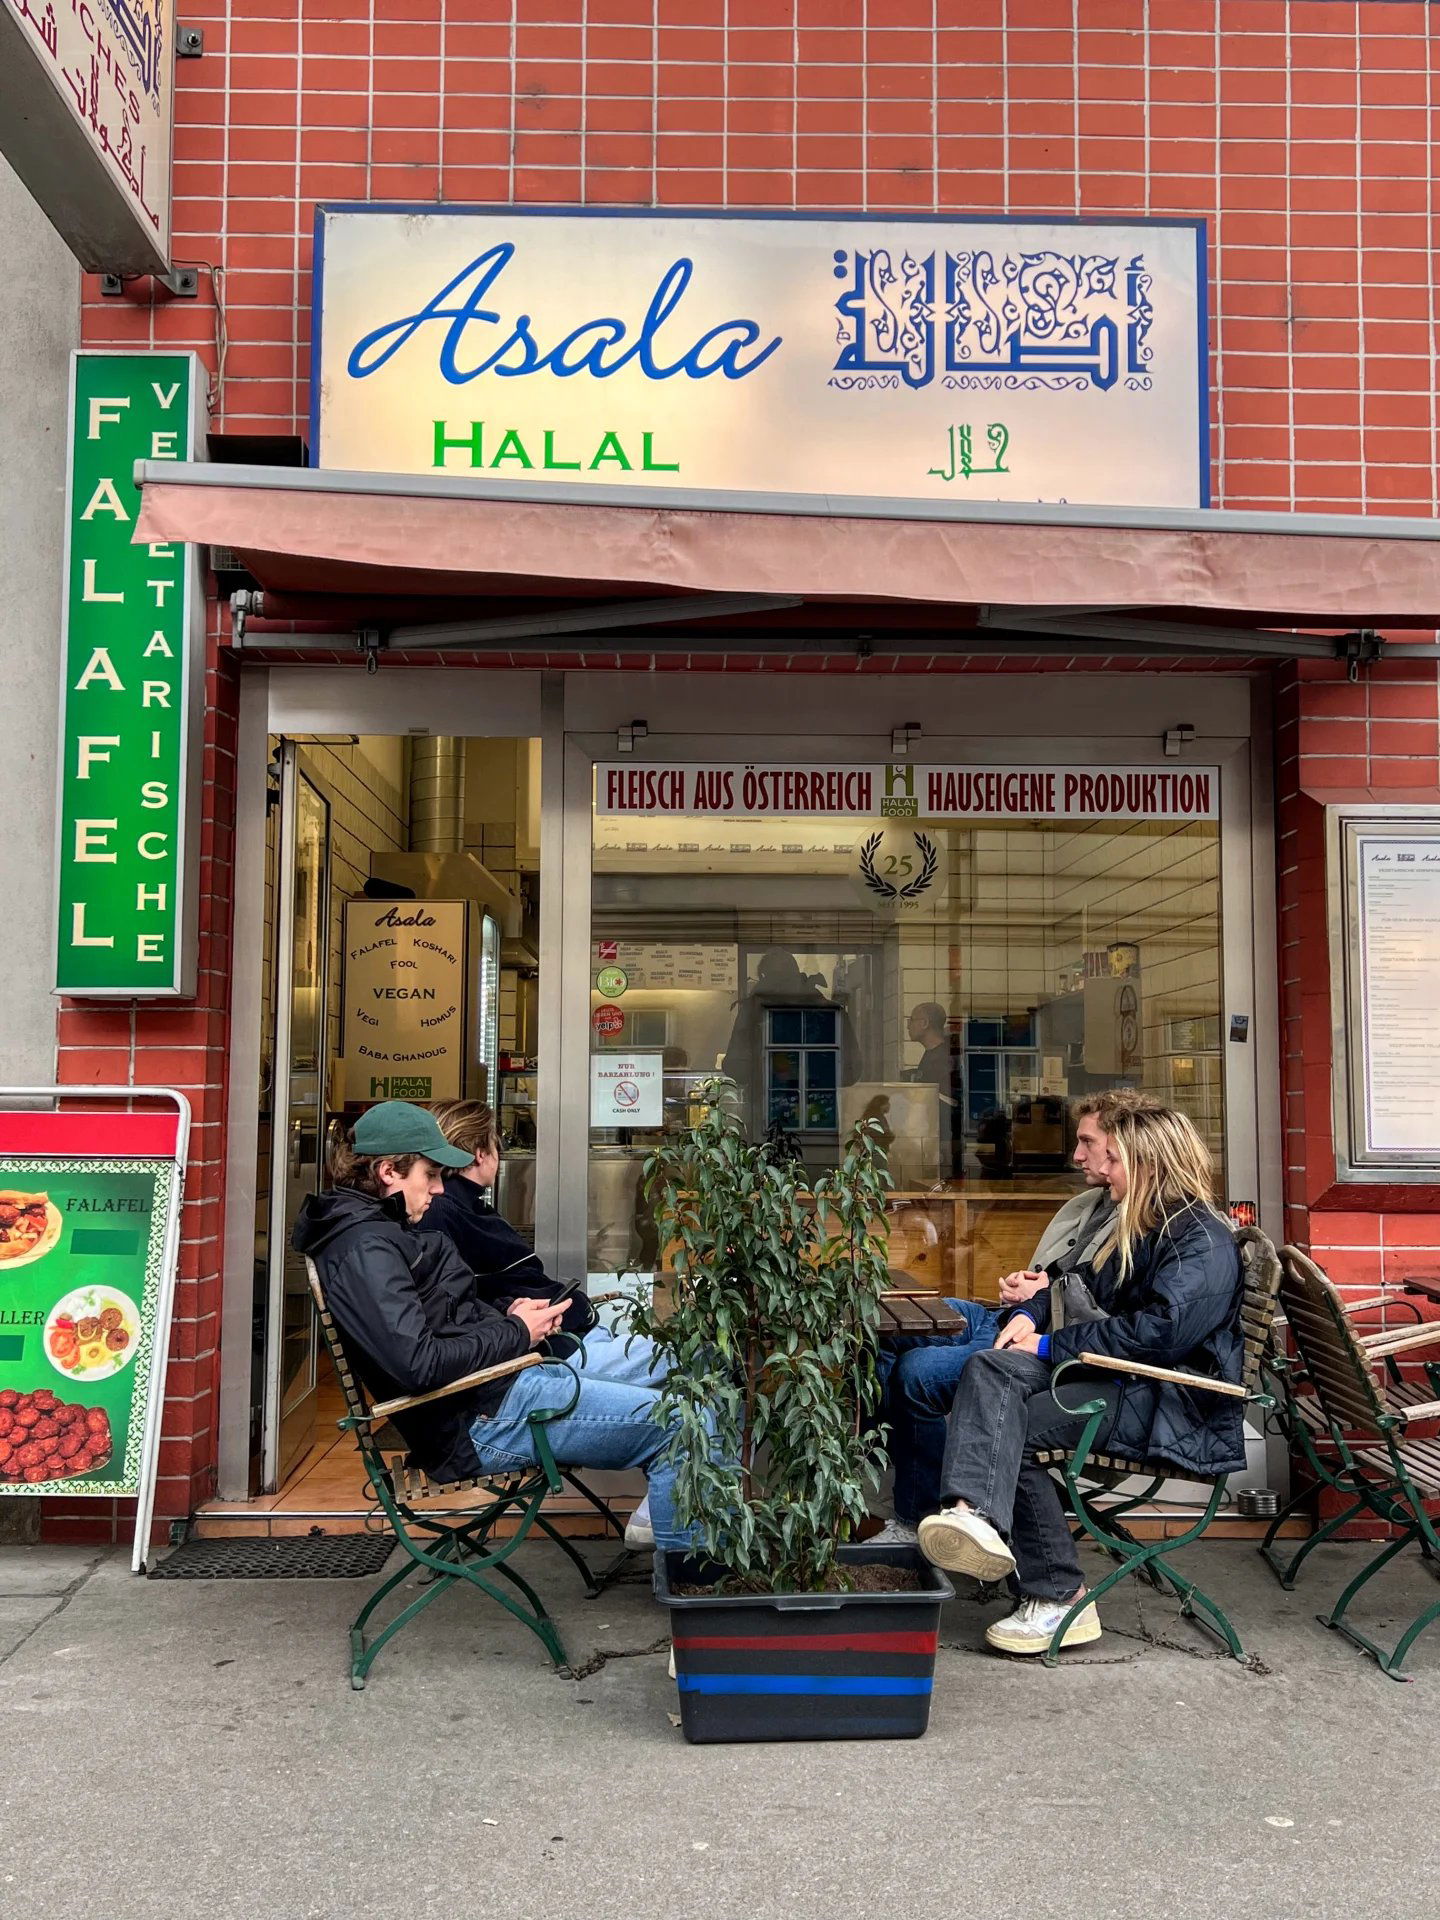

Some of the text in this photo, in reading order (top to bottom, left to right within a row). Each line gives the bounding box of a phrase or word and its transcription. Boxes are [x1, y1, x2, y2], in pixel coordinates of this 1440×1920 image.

[347, 243, 782, 384] Asala
[433, 420, 681, 473] HALAL
[71, 396, 131, 948] FALAFEL
[136, 383, 181, 963] VEETARISCHE
[607, 765, 872, 811] FLEISCH AUS ÖSTERREICH
[928, 772, 1210, 813] HAUSEIGENE PRODUKTION
[882, 798, 917, 807] HALAL
[882, 808, 912, 817] FOOD
[884, 855, 913, 876] 25
[899, 901, 919, 910] 1995
[374, 906, 437, 928] Asala
[350, 938, 458, 965] FALAFEL KOSHARI
[390, 960, 418, 970] FOOL
[373, 988, 436, 1000] VEGAN
[356, 1005, 457, 1028] VEGI HOMUS
[596, 1022, 614, 1032] yelp
[358, 1045, 447, 1062] BABA GHANOUG
[393, 1078, 431, 1087] HALAL
[393, 1088, 426, 1098] FOOD
[66, 1198, 149, 1213] FALAFEL
